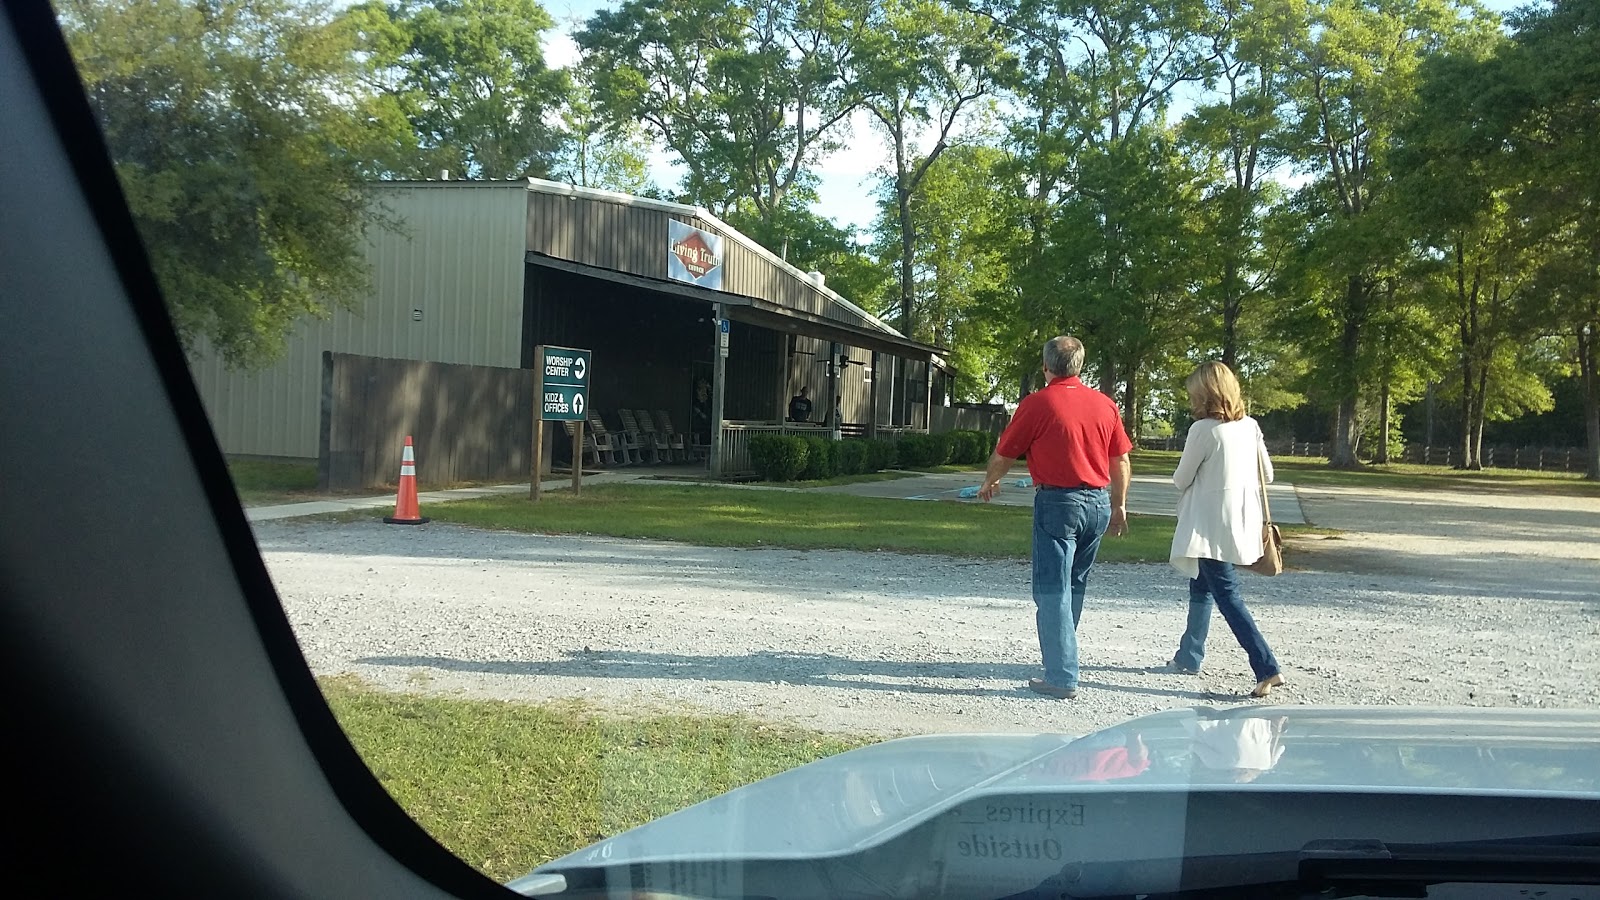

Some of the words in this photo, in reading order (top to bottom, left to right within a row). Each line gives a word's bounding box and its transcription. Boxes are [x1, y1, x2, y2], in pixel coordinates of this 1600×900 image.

[670, 238, 698, 264] Living
[700, 247, 720, 266] Truth
[545, 355, 573, 368] WORSHIP
[545, 366, 569, 377] CENTER
[544, 392, 559, 403] KIDZ
[559, 393, 564, 403] &
[544, 402, 569, 413] OFFICES
